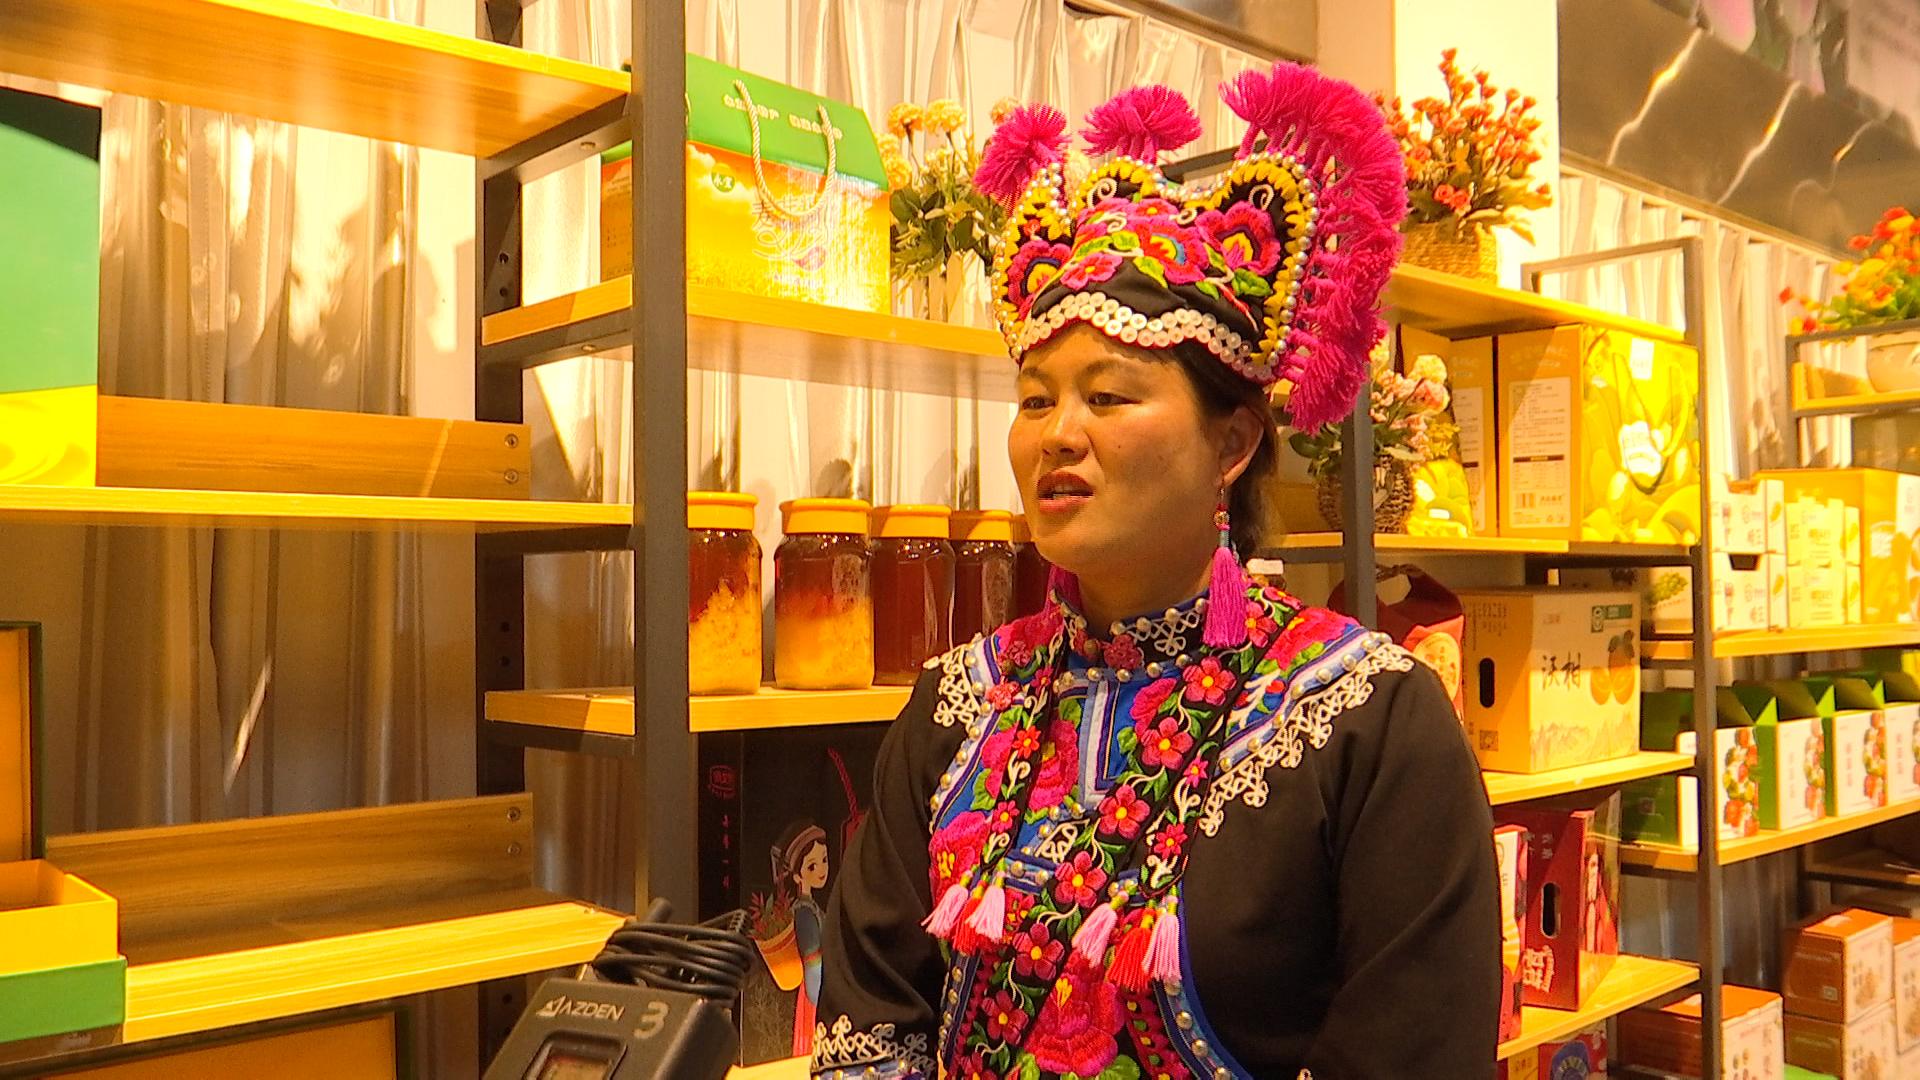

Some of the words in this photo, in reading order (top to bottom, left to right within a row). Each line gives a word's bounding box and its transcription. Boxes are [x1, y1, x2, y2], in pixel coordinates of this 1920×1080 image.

[1541, 651, 1581, 691] 沃柑
[558, 1001, 625, 1020] AZDEN
[634, 1001, 669, 1039] 3
